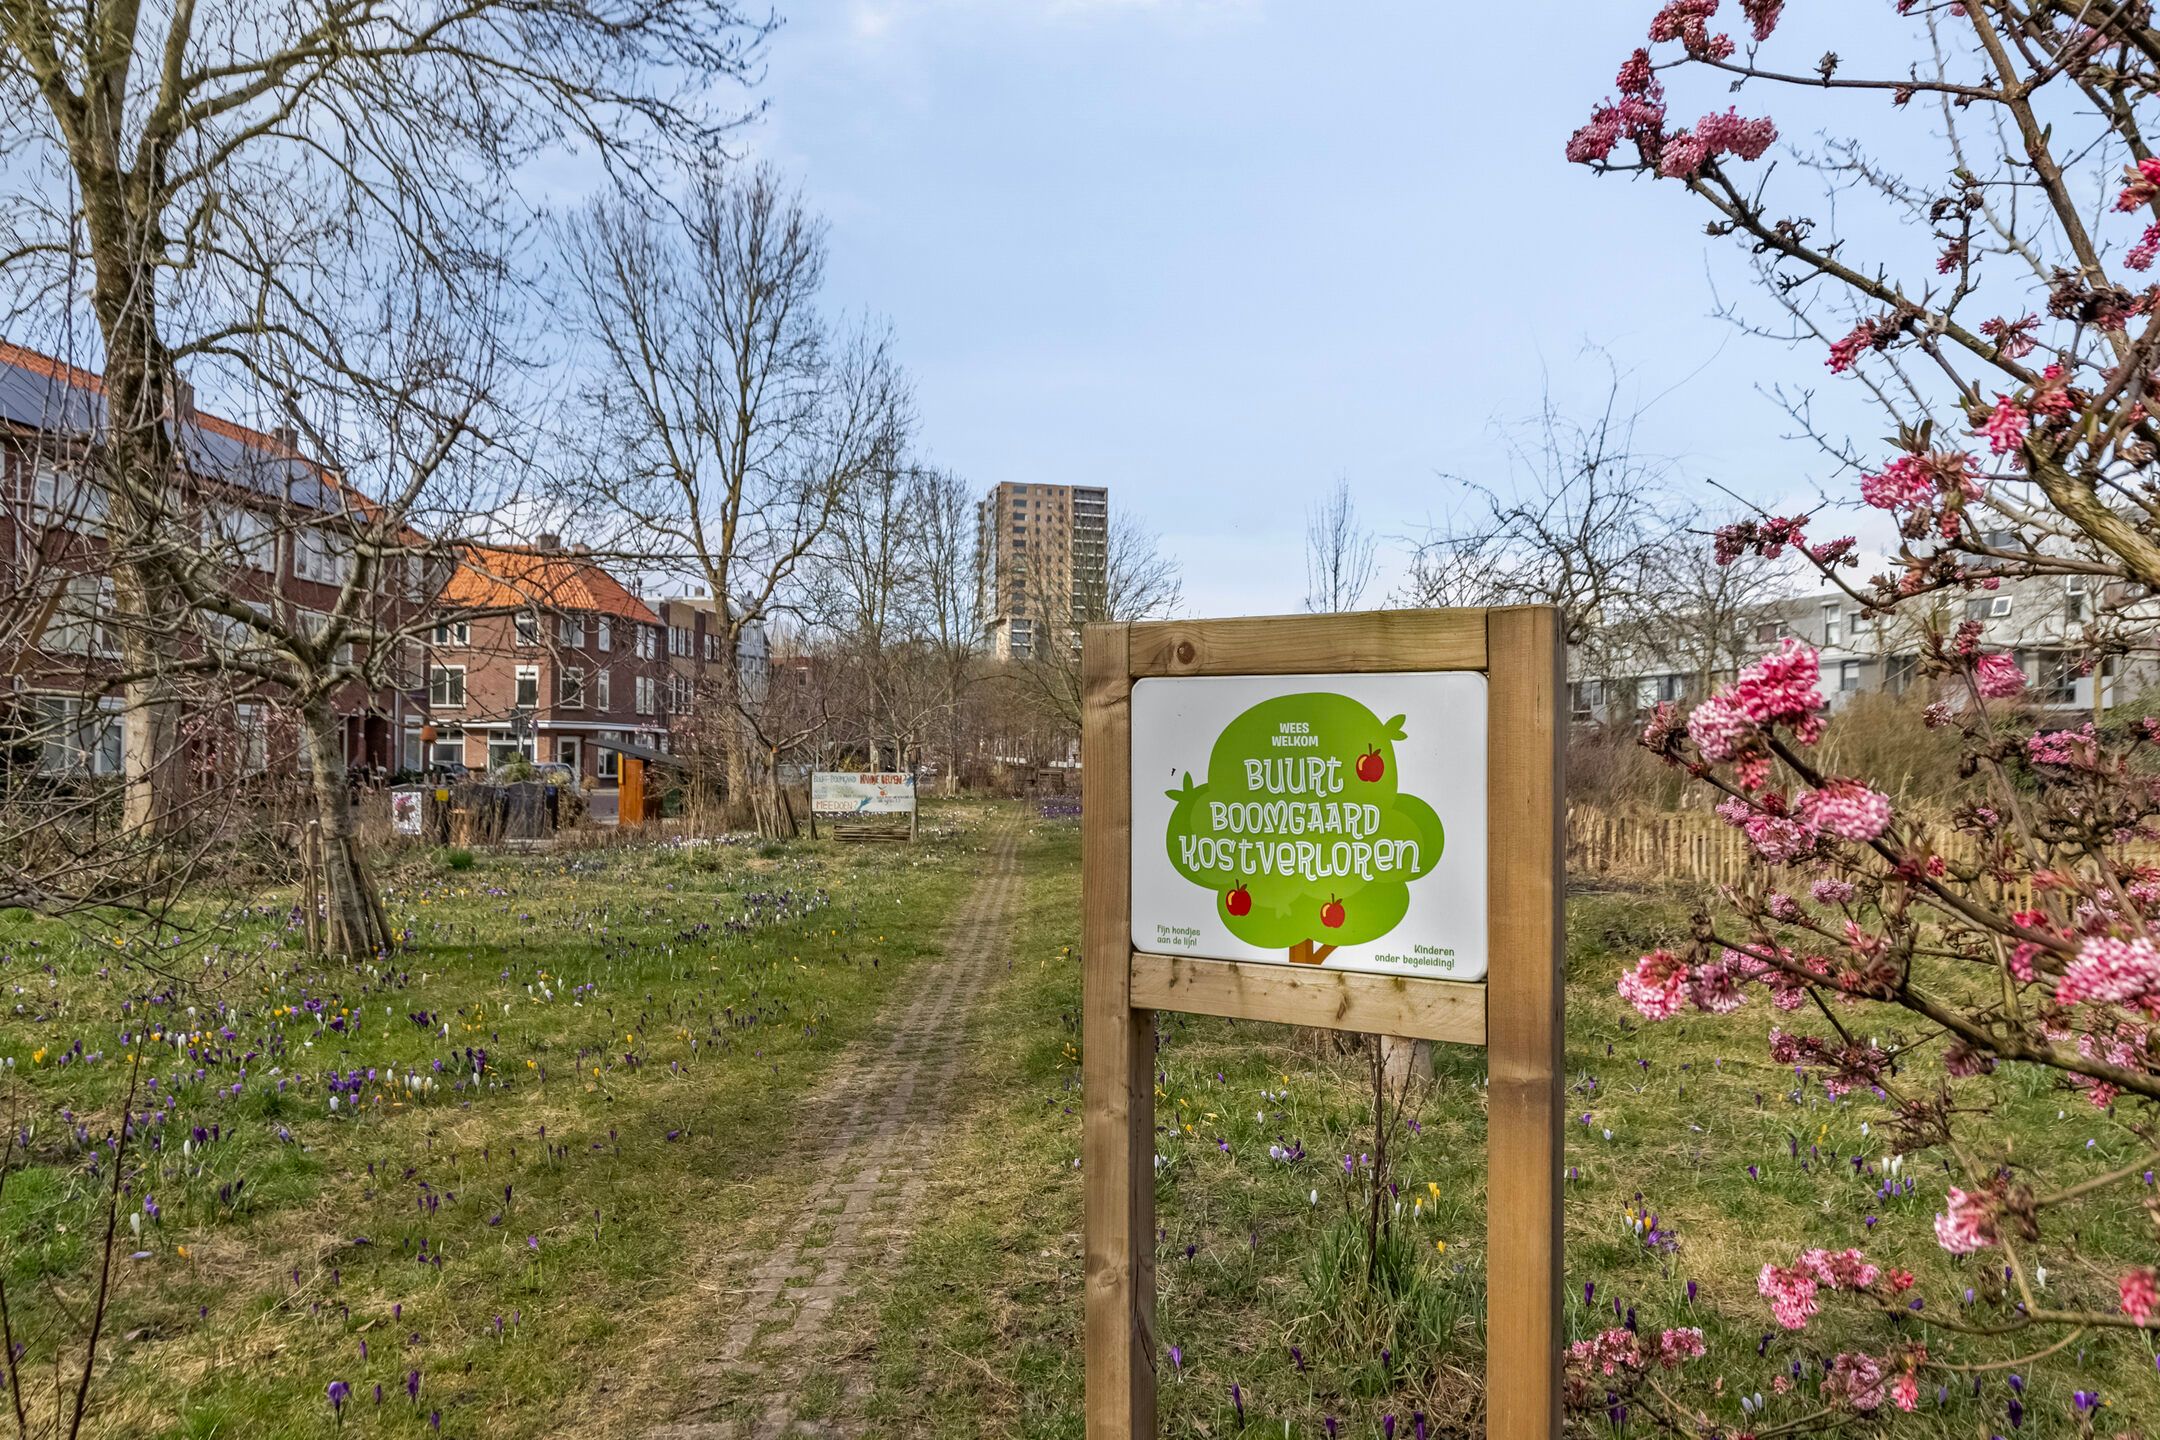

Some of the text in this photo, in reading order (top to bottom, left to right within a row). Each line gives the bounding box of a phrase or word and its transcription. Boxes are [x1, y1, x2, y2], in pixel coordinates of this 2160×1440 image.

[1279, 722, 1310, 734] WEES
[1271, 735, 1319, 747] WELKOM
[1209, 800, 1381, 841] BOOMGAARD
[1171, 926, 1201, 939] hondjes
[1157, 936, 1171, 945] aan
[1172, 936, 1182, 945] de
[1414, 944, 1455, 957] Kinderen
[1374, 953, 1455, 971] onder begeleiding!
